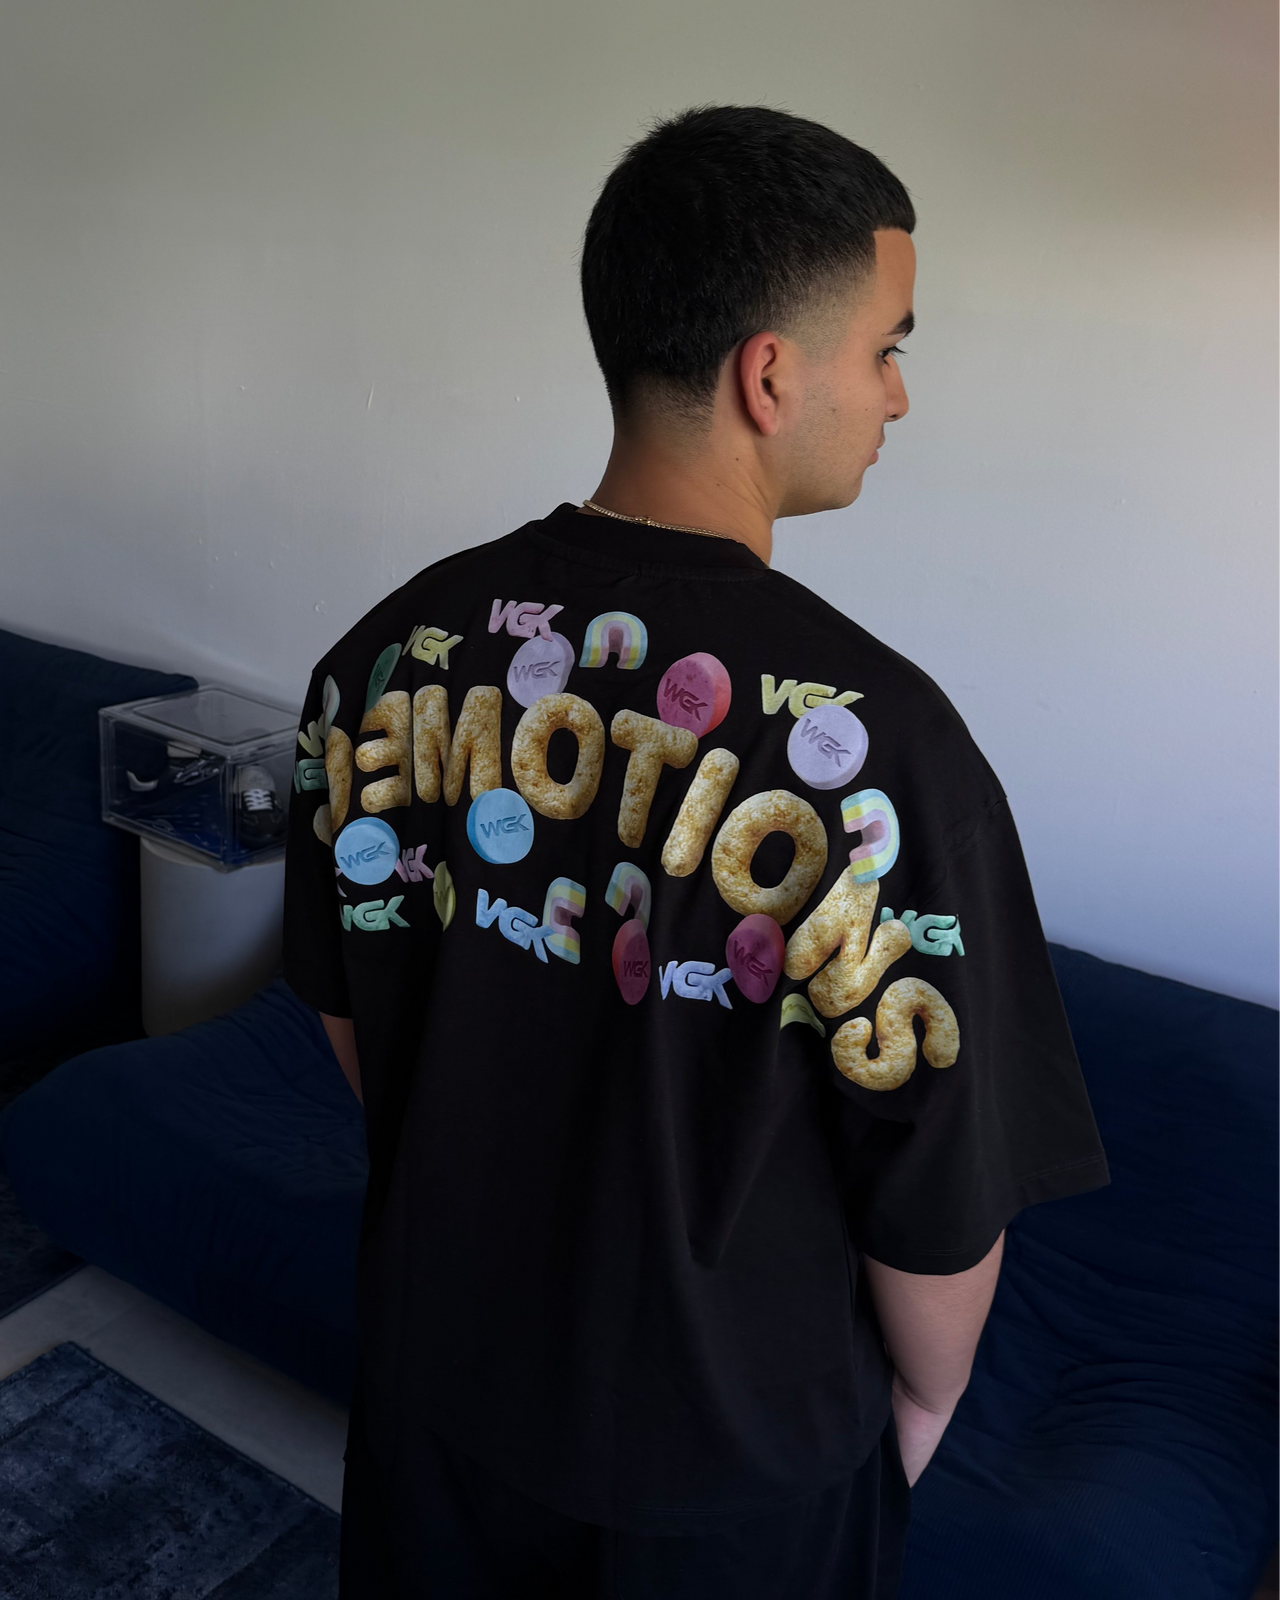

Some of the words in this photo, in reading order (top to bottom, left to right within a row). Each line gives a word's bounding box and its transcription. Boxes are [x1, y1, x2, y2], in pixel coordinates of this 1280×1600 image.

[514, 660, 561, 683] WGK
[664, 678, 708, 721] WGK
[800, 718, 851, 768] WGK
[480, 814, 530, 839] WGK
[340, 841, 391, 869] WGK
[623, 960, 649, 979] WGK
[733, 940, 774, 988] WGK
